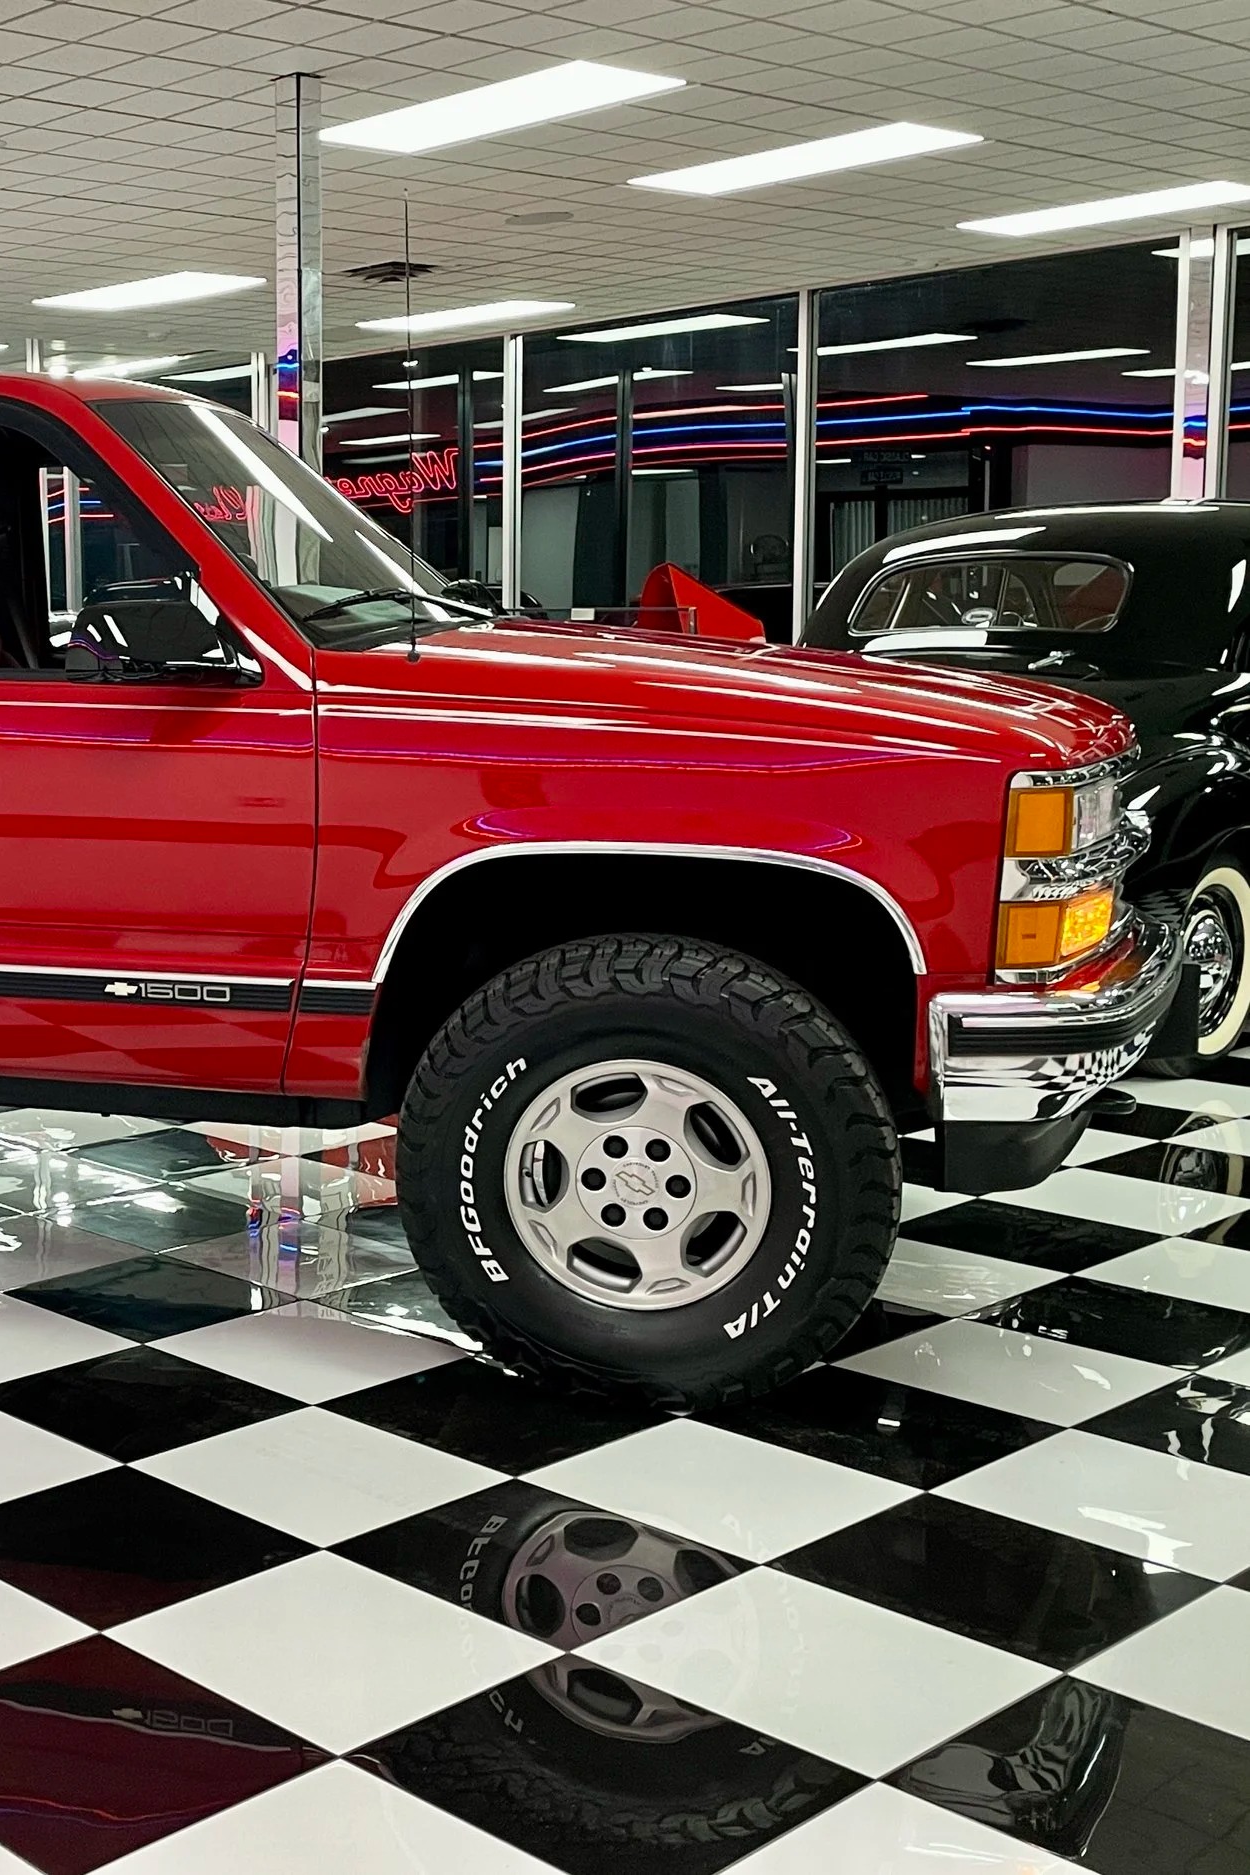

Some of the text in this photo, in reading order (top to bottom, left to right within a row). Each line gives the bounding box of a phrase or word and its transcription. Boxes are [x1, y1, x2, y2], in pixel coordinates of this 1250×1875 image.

[138, 982, 231, 1003] 1500
[459, 1056, 527, 1283] BFGoodrich
[722, 1075, 818, 1340] All-Terrain T/A
